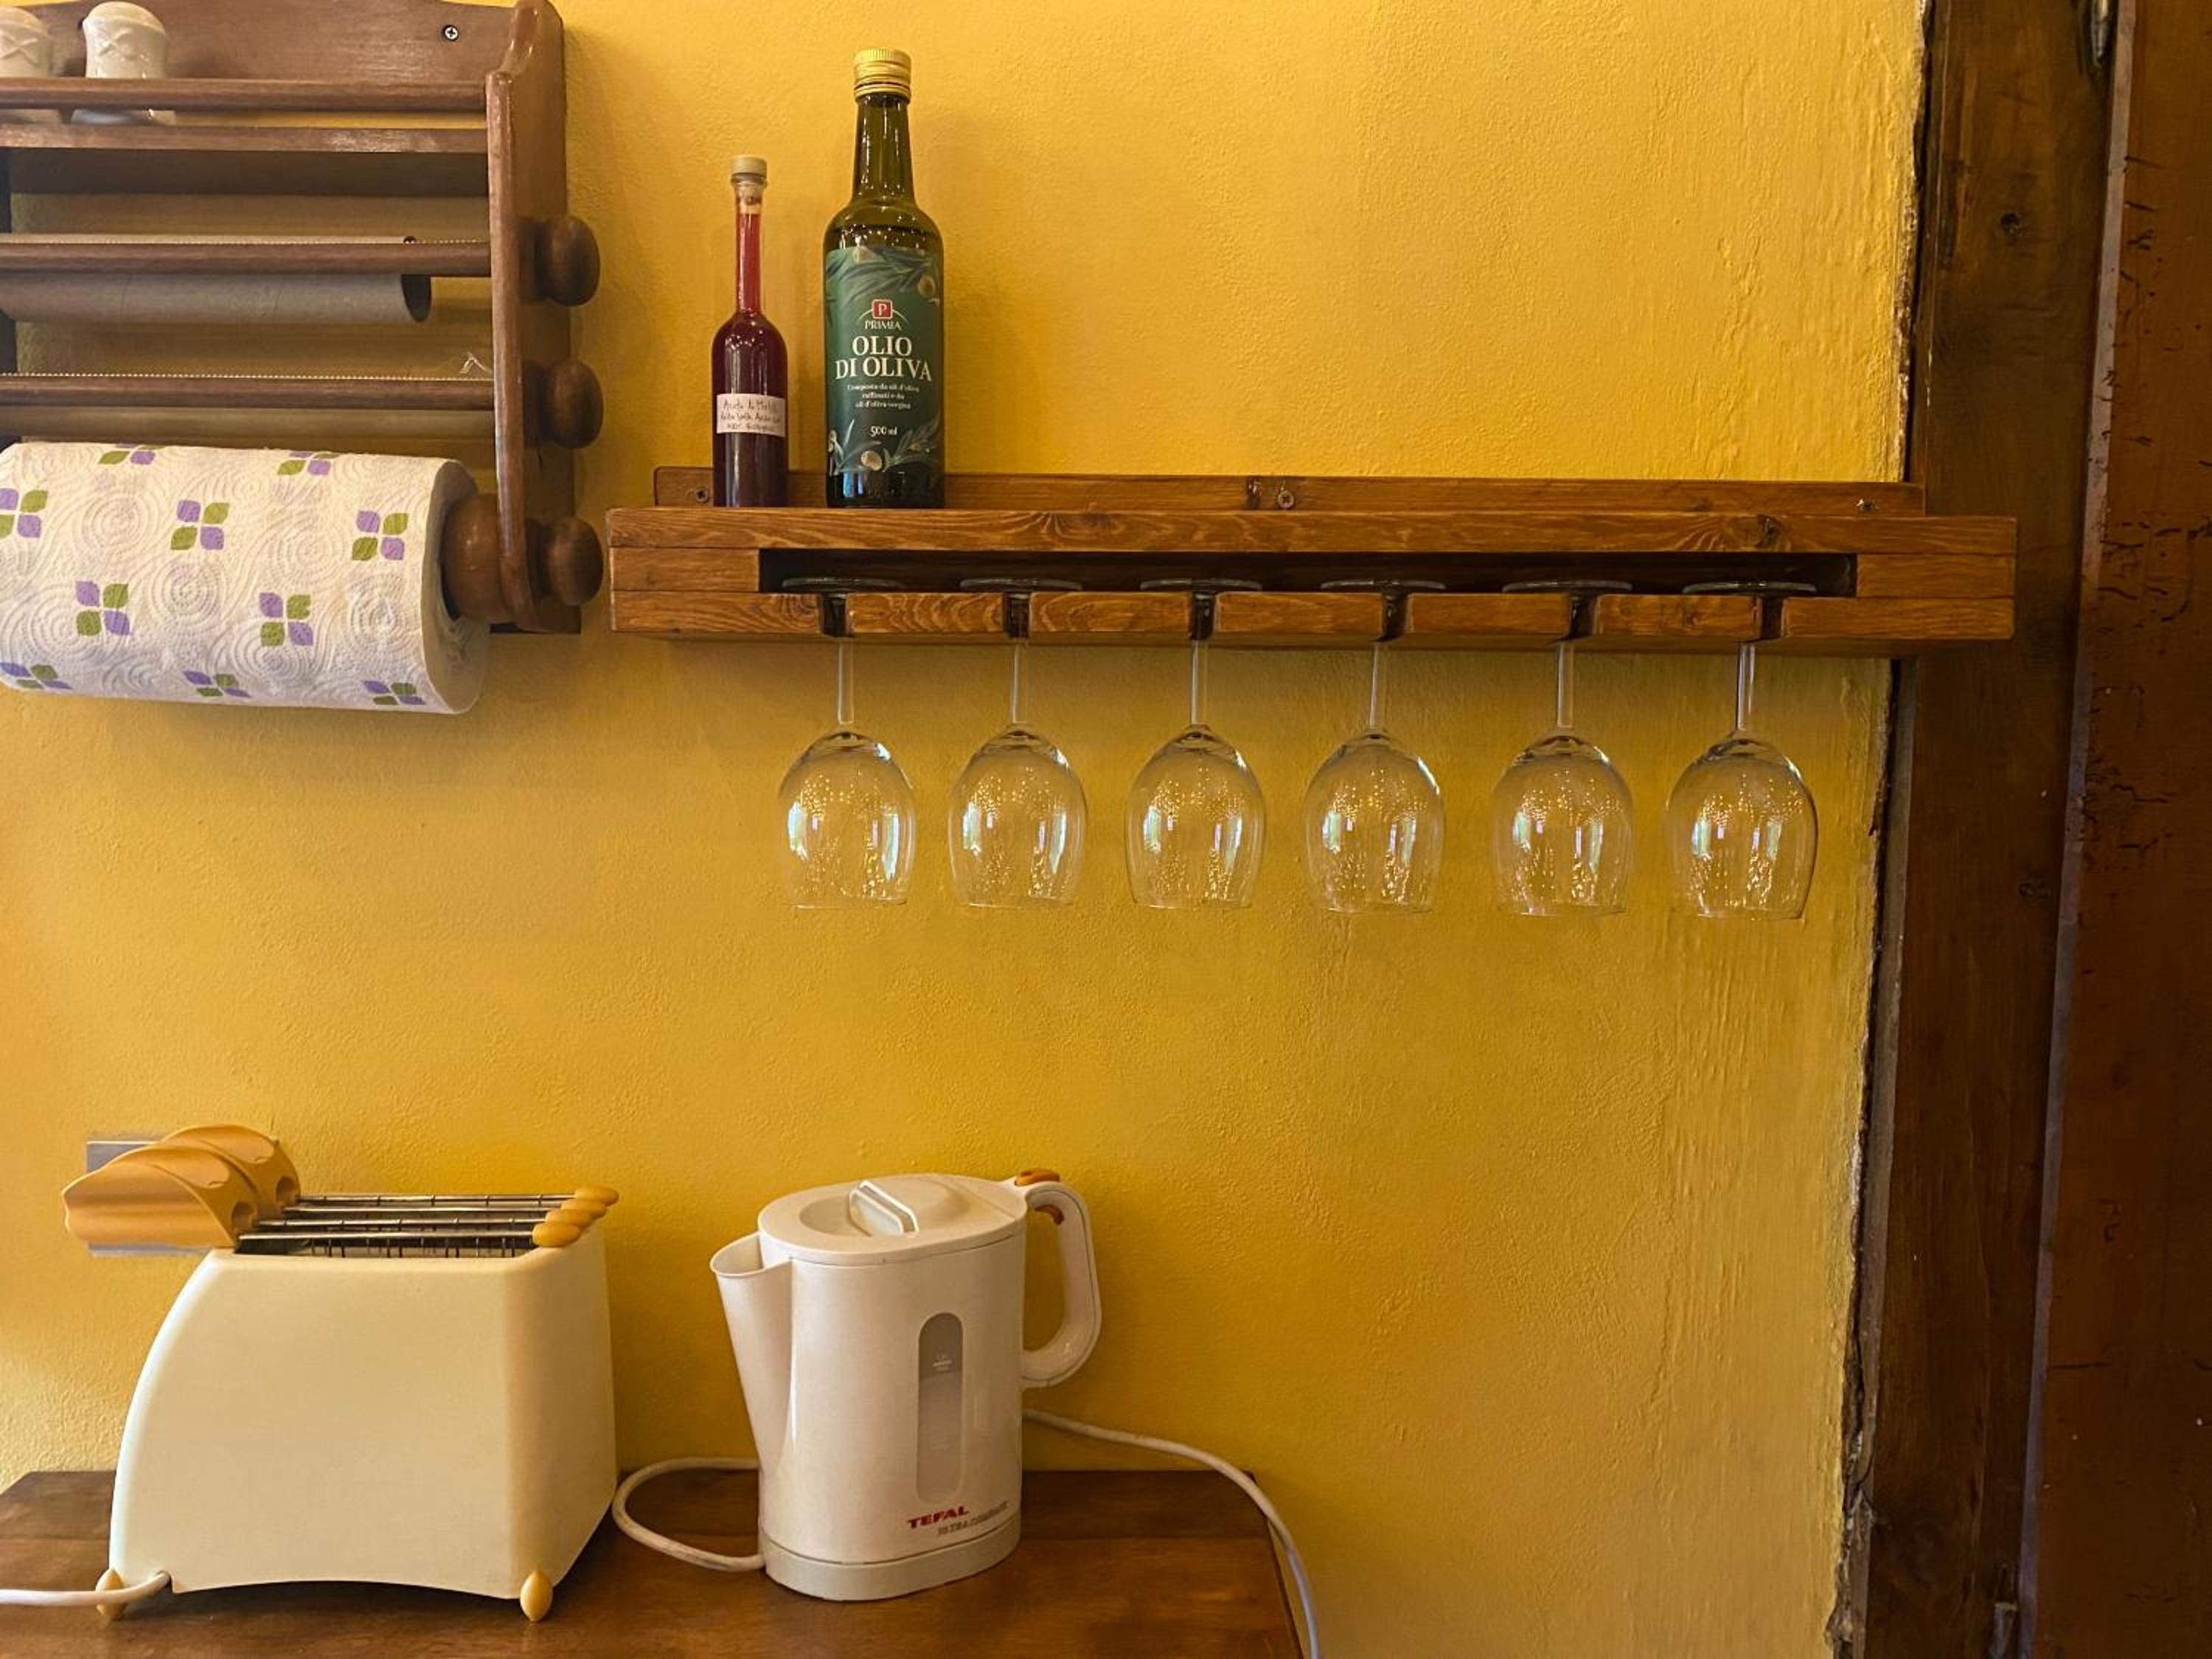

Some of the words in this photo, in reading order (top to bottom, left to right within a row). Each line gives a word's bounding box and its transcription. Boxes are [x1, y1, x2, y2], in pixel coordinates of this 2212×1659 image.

[864, 319, 902, 330] PRIMIA
[852, 335, 913, 357] OLIO
[835, 357, 858, 380] DI
[862, 355, 932, 382] OLIVA
[870, 425, 887, 437] 500
[888, 426, 897, 436] ml
[907, 1506, 970, 1529] TEFAL
